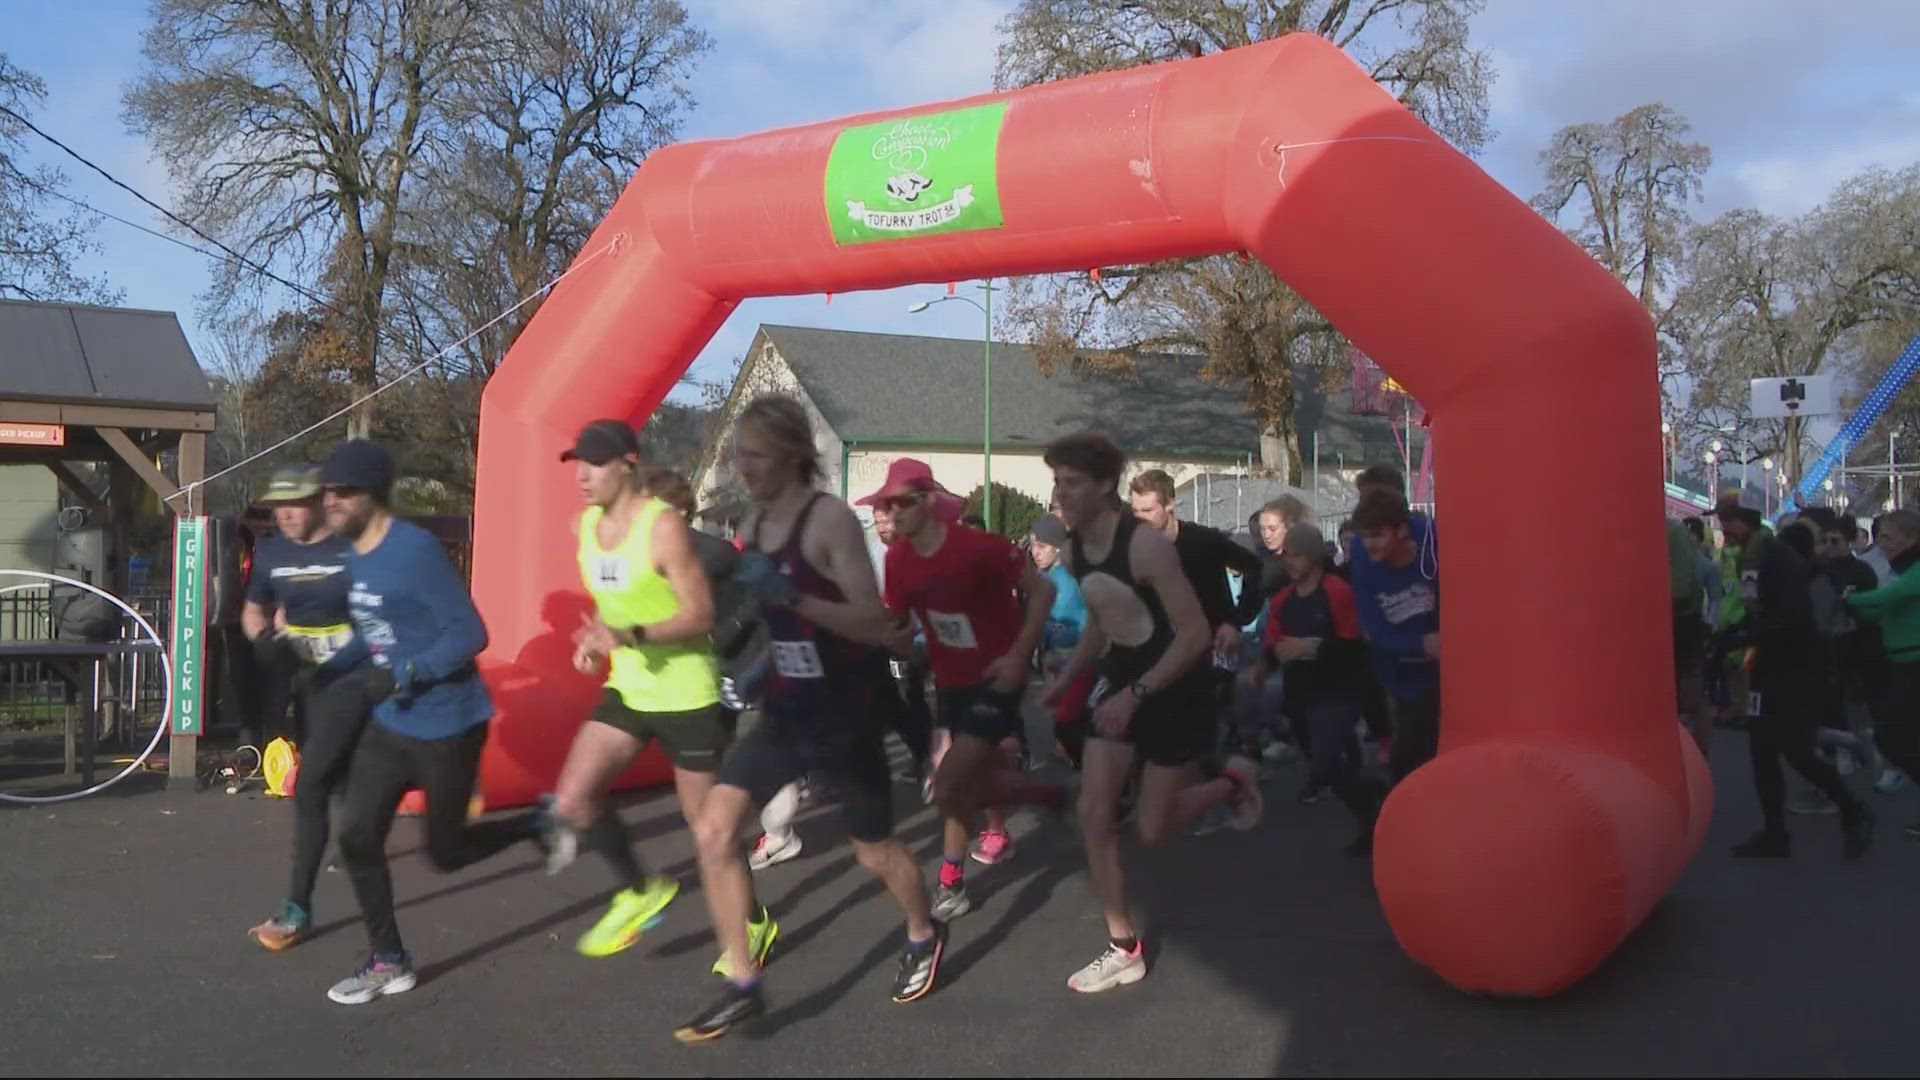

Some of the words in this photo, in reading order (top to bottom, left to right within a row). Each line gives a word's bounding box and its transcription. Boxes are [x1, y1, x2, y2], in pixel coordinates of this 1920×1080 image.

[868, 214, 914, 227] TOFURKY
[919, 209, 943, 225] TROT
[18, 429, 46, 439] PICKUP
[184, 538, 195, 619] GRILL
[182, 627, 194, 691] PICK
[181, 699, 192, 730] UP
